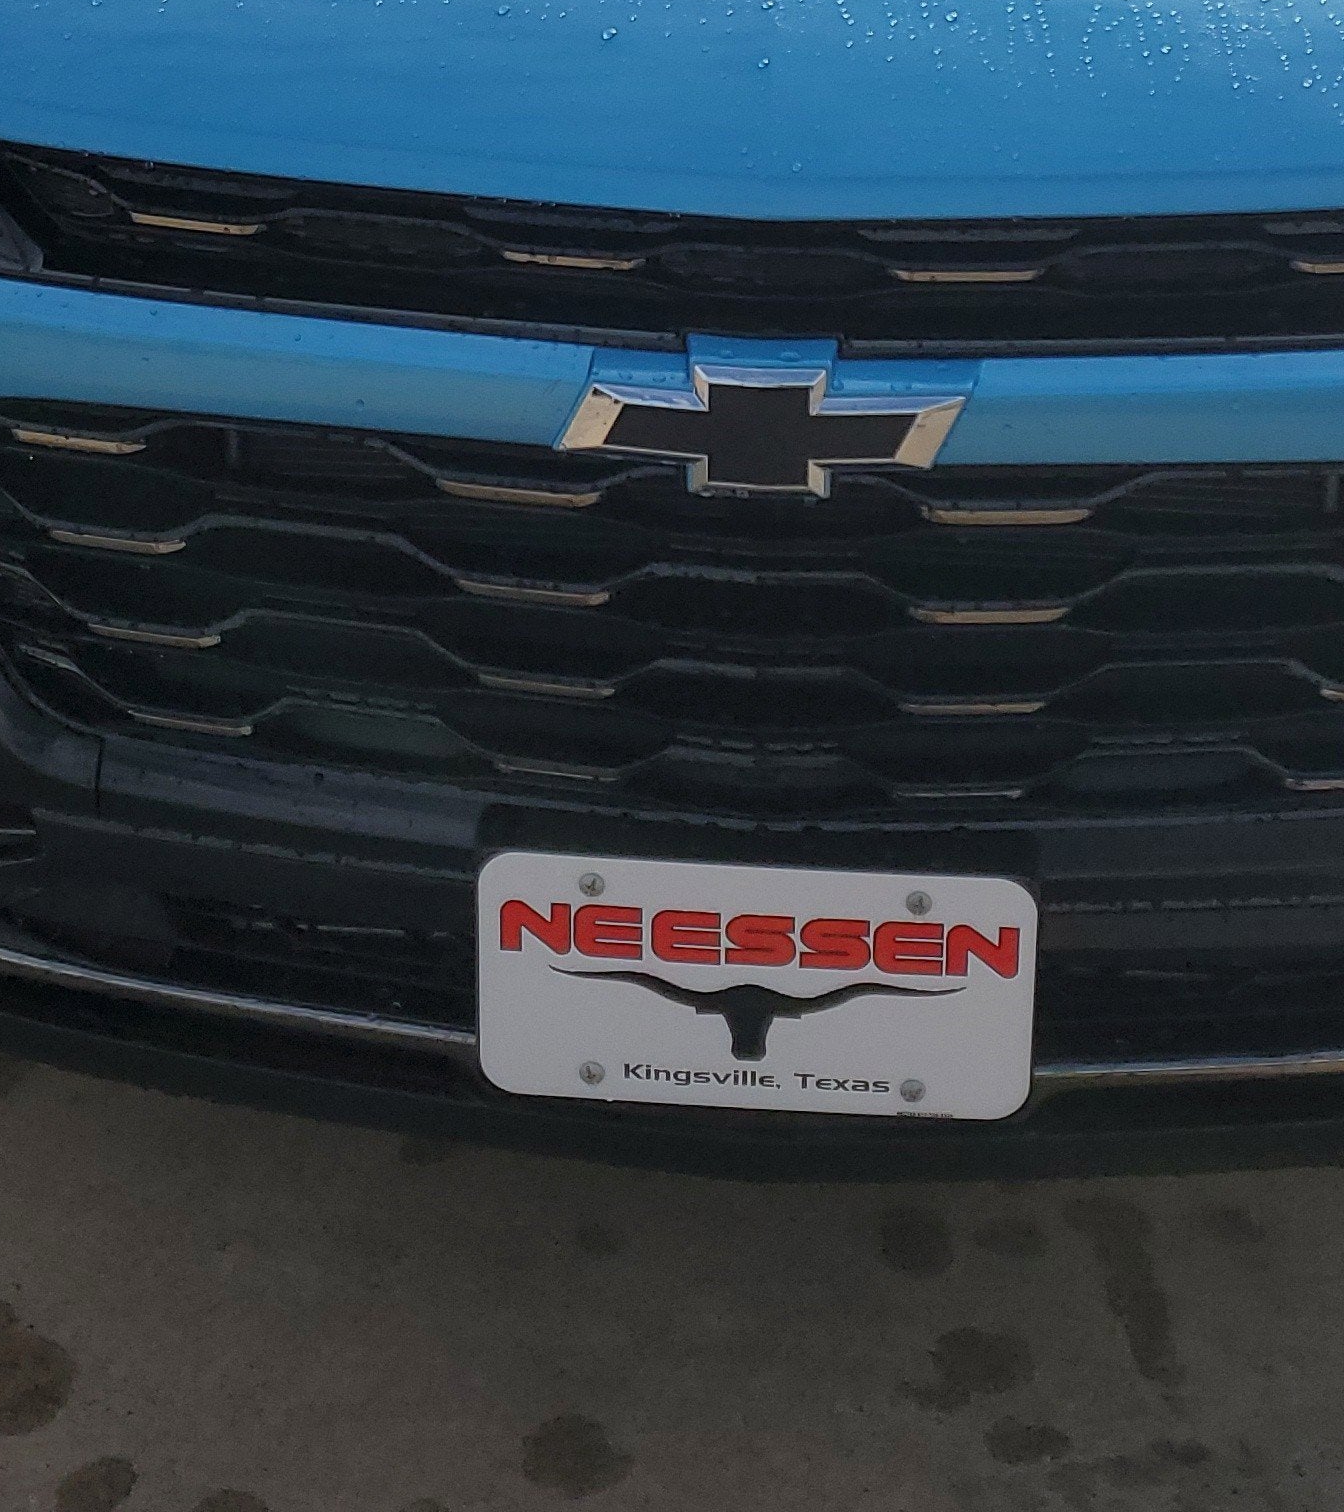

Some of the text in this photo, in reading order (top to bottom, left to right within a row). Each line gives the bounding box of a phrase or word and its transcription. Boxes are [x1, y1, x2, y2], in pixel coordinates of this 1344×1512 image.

[499, 899, 1021, 979] NEESSEN
[623, 1062, 891, 1094] Kingsville, Texas
